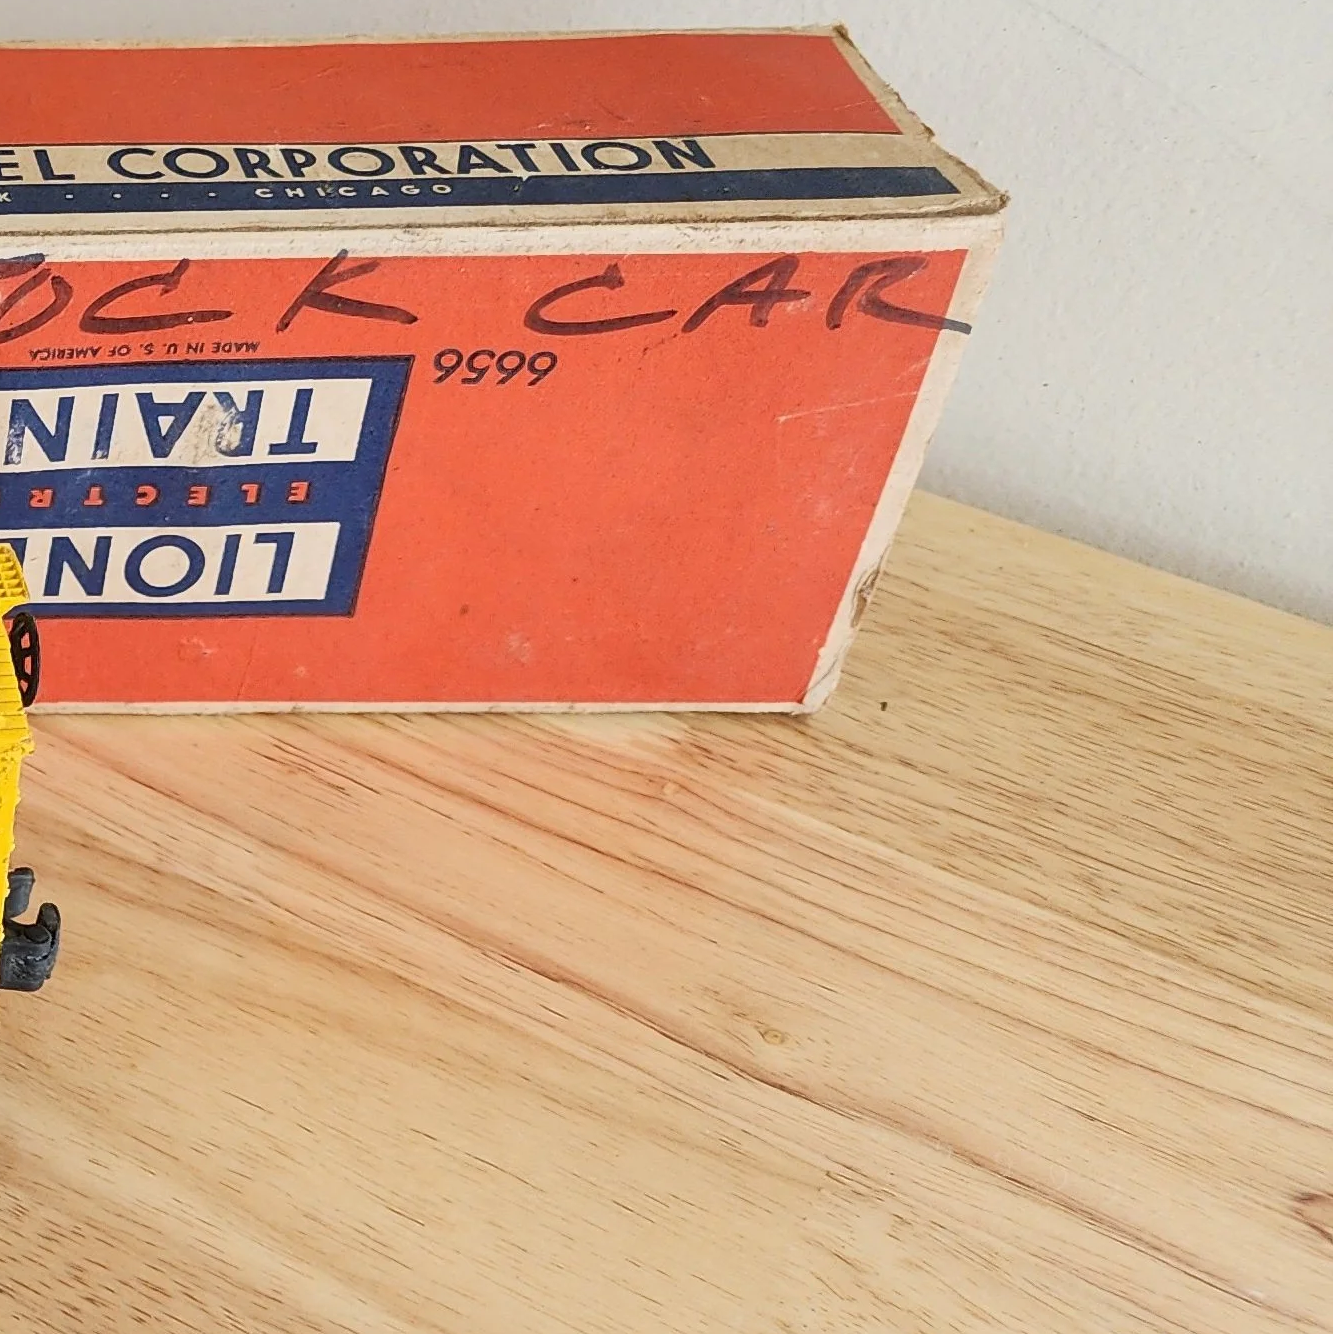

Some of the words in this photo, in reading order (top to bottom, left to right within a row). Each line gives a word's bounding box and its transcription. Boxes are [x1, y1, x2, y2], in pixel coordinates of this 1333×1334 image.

[107, 138, 717, 181] CORPORATION
[254, 182, 453, 199] CHICAGO
[524, 254, 972, 336] CAR
[28, 345, 102, 361] AMERICA
[108, 344, 131, 357] OF
[185, 342, 204, 355] IN
[211, 340, 261, 354] MADE
[433, 347, 558, 387] 6656
